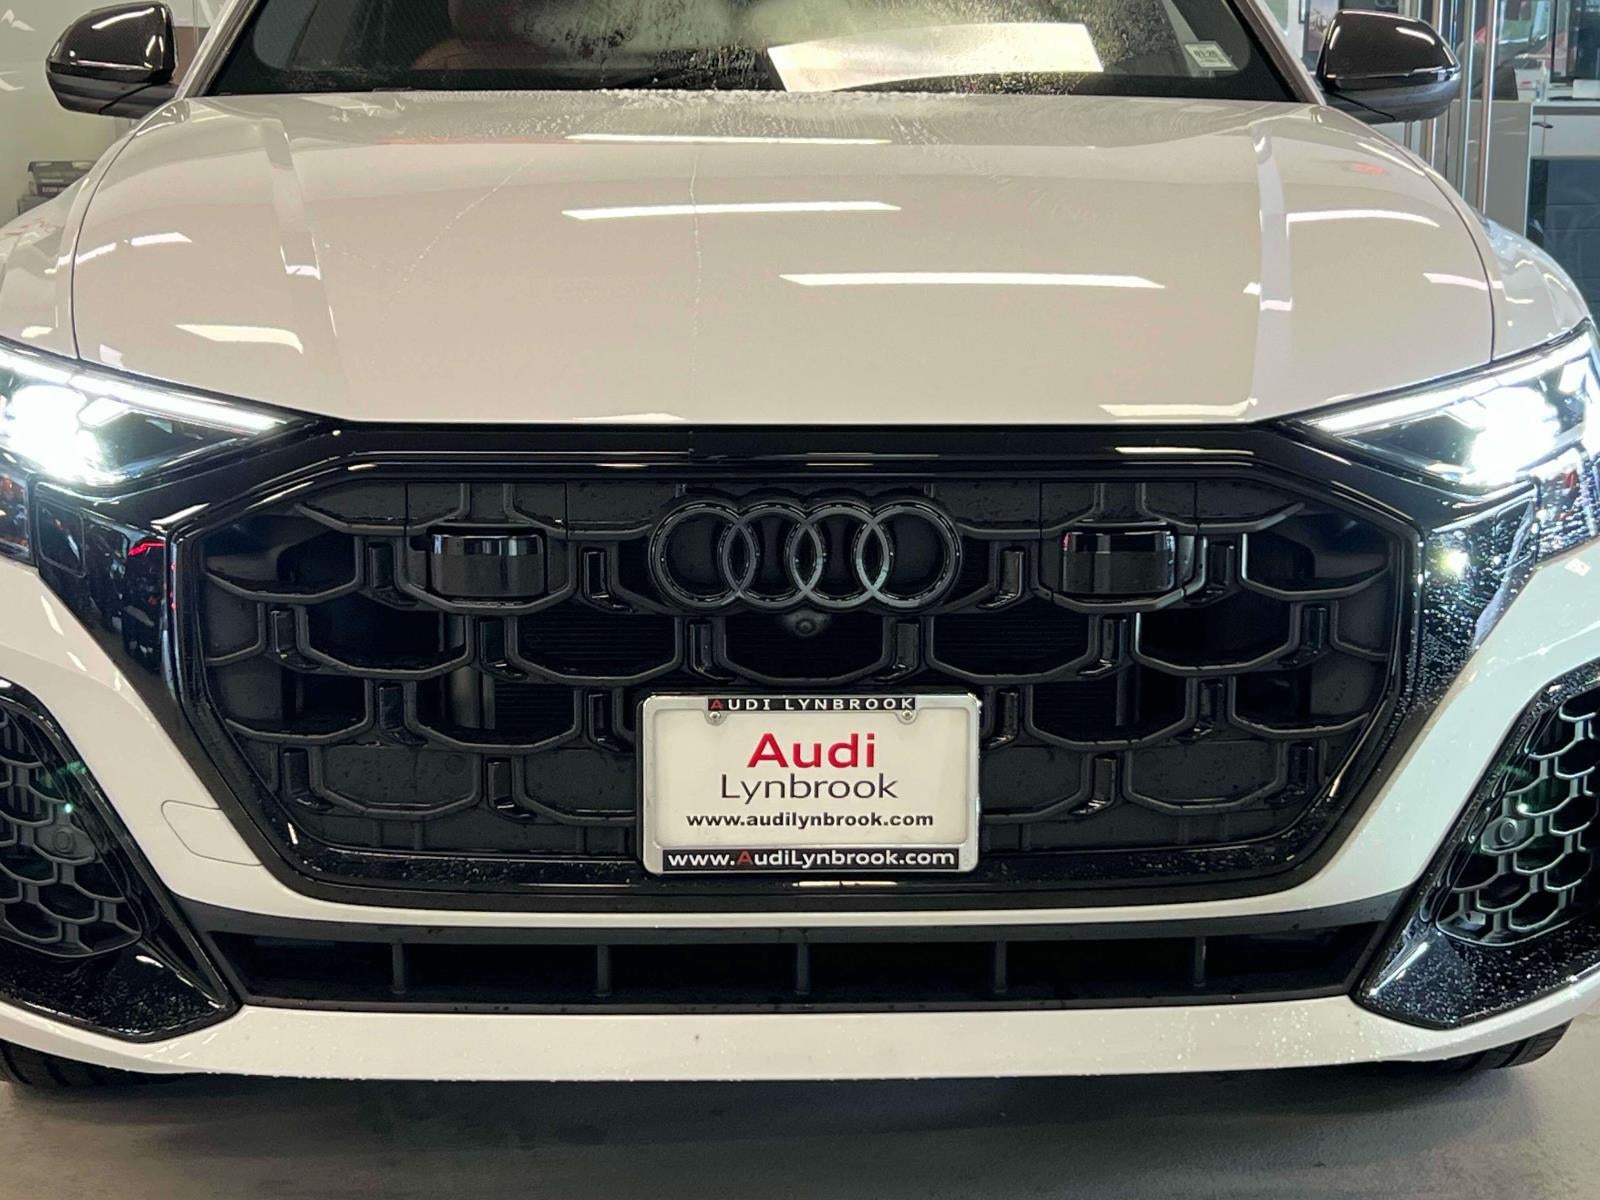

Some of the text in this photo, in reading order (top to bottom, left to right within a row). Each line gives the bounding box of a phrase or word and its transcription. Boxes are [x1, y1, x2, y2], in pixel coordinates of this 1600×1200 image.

[710, 698, 913, 710] AUDI LYNBROOK
[747, 733, 875, 767] Audi
[721, 773, 898, 804] Lynbrook
[686, 812, 933, 828] www.audilynbrook.com
[668, 850, 954, 868] www.AudiLynbrook.com
